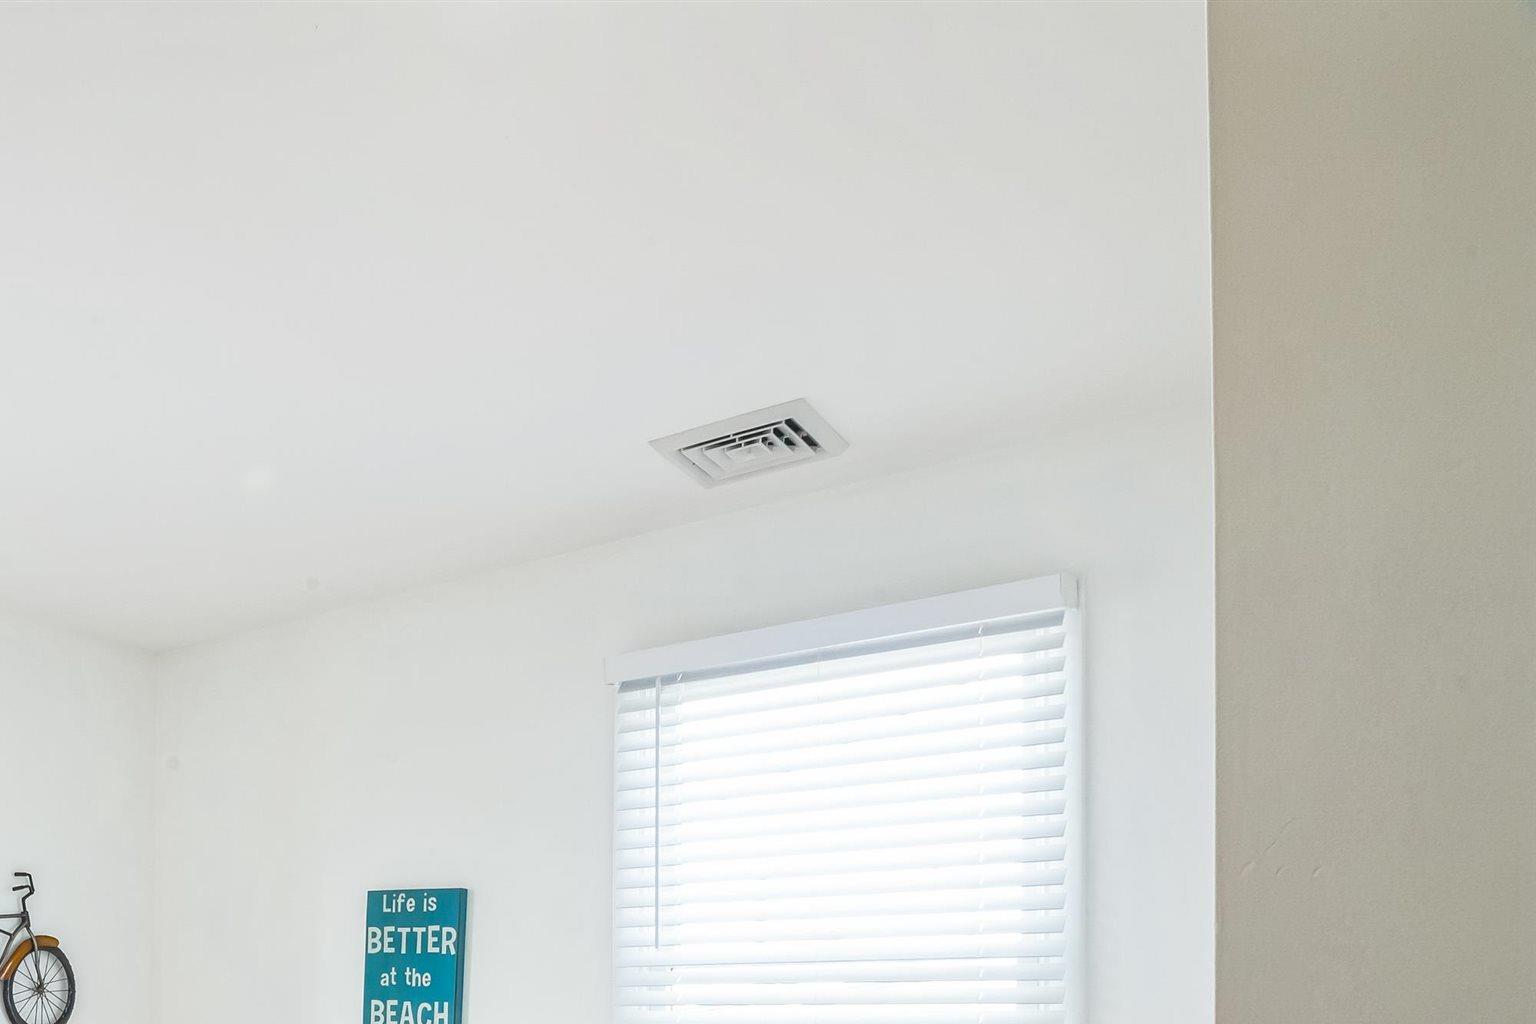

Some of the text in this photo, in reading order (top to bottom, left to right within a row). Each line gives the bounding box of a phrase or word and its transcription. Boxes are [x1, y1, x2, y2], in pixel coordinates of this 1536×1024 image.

[382, 892, 437, 913] Life is
[367, 925, 457, 955] BETTER
[380, 967, 432, 987] at the
